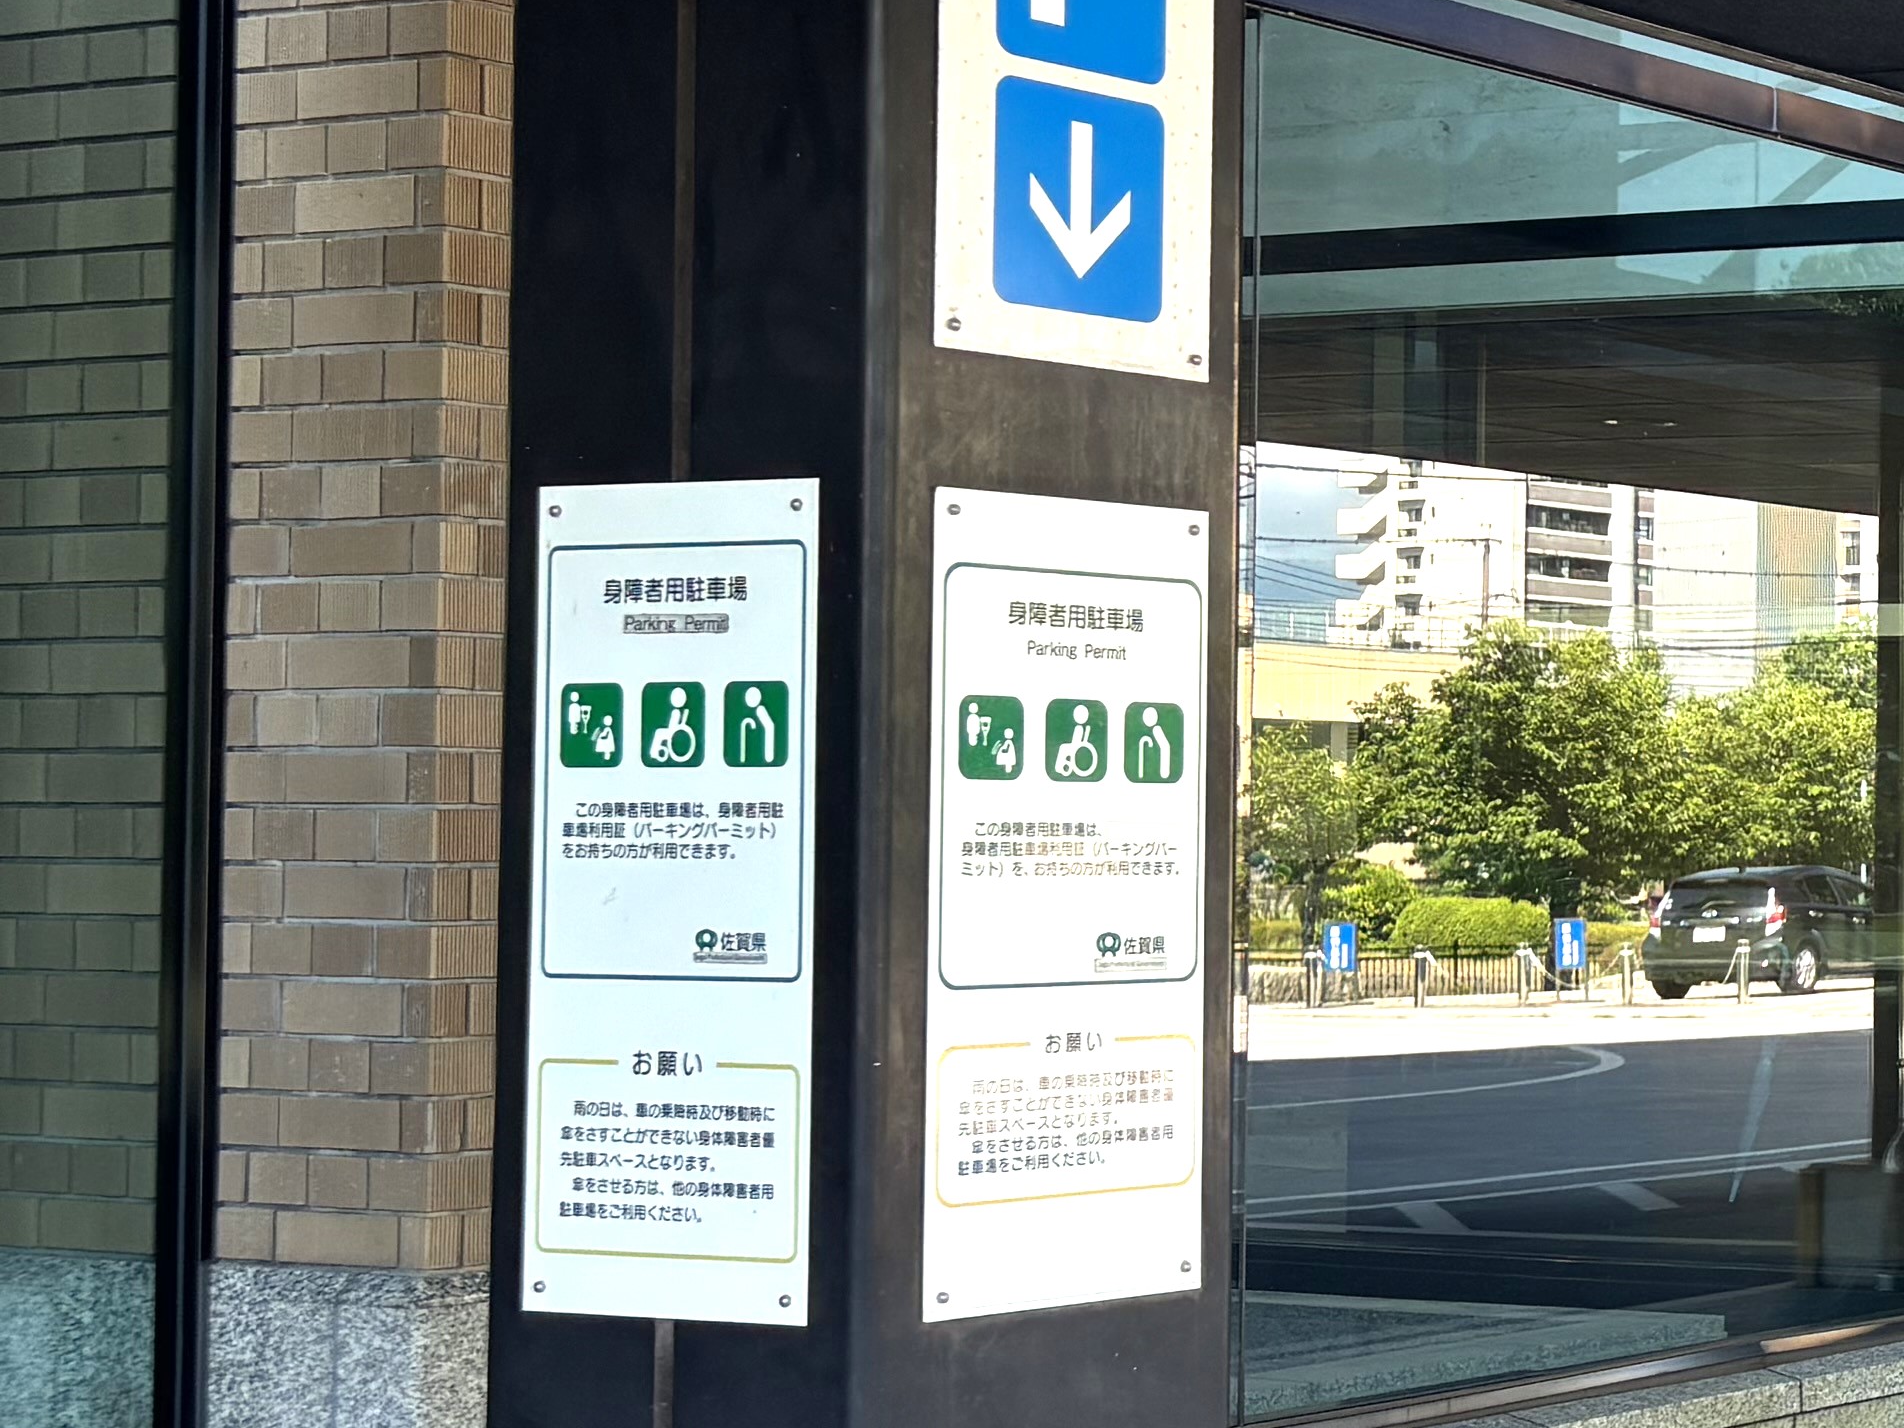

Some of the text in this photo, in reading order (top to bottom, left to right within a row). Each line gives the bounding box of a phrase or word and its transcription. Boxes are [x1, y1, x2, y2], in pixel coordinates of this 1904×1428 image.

[603, 575, 748, 604] 身障者用駐車場
[623, 614, 676, 632] Parking
[1008, 600, 1144, 632] 身障者用駐車場
[1027, 639, 1127, 660] Parking Permit
[561, 843, 737, 860] をお持ちの方が利用できます。
[721, 931, 767, 953] 佐賀県
[1124, 936, 1165, 955] 佐賀県
[1045, 1032, 1102, 1054] お願い
[632, 1049, 703, 1077] お願い
